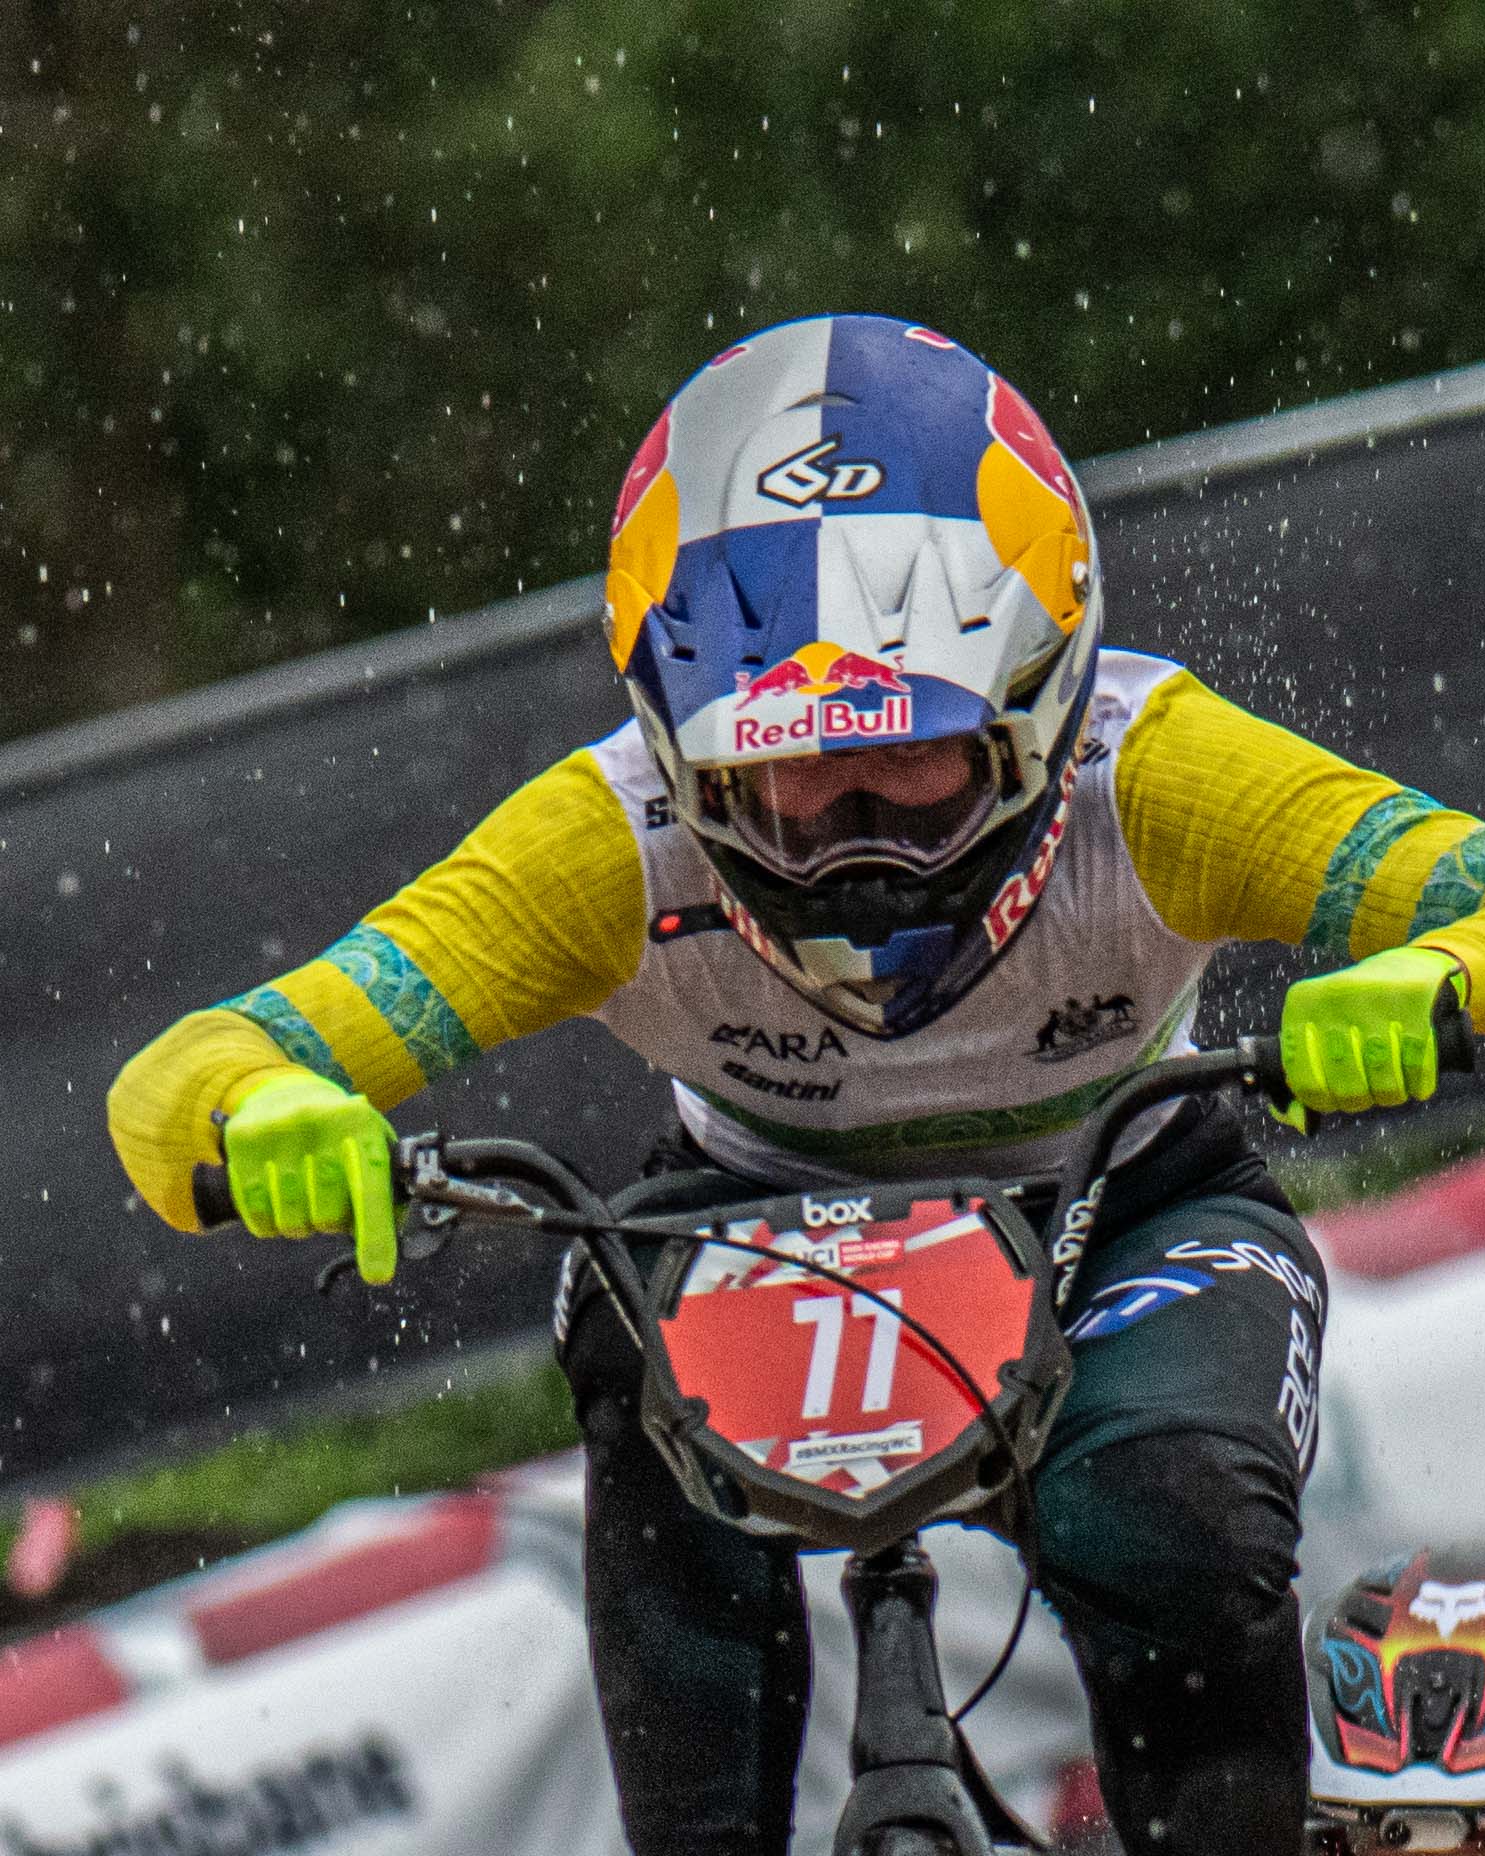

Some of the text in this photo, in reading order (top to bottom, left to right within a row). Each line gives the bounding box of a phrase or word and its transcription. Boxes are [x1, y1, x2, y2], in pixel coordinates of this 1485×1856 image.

[757, 432, 886, 510] 6D
[733, 696, 911, 752] Red Bull
[801, 1194, 873, 1228] box
[793, 1287, 903, 1418] 77
